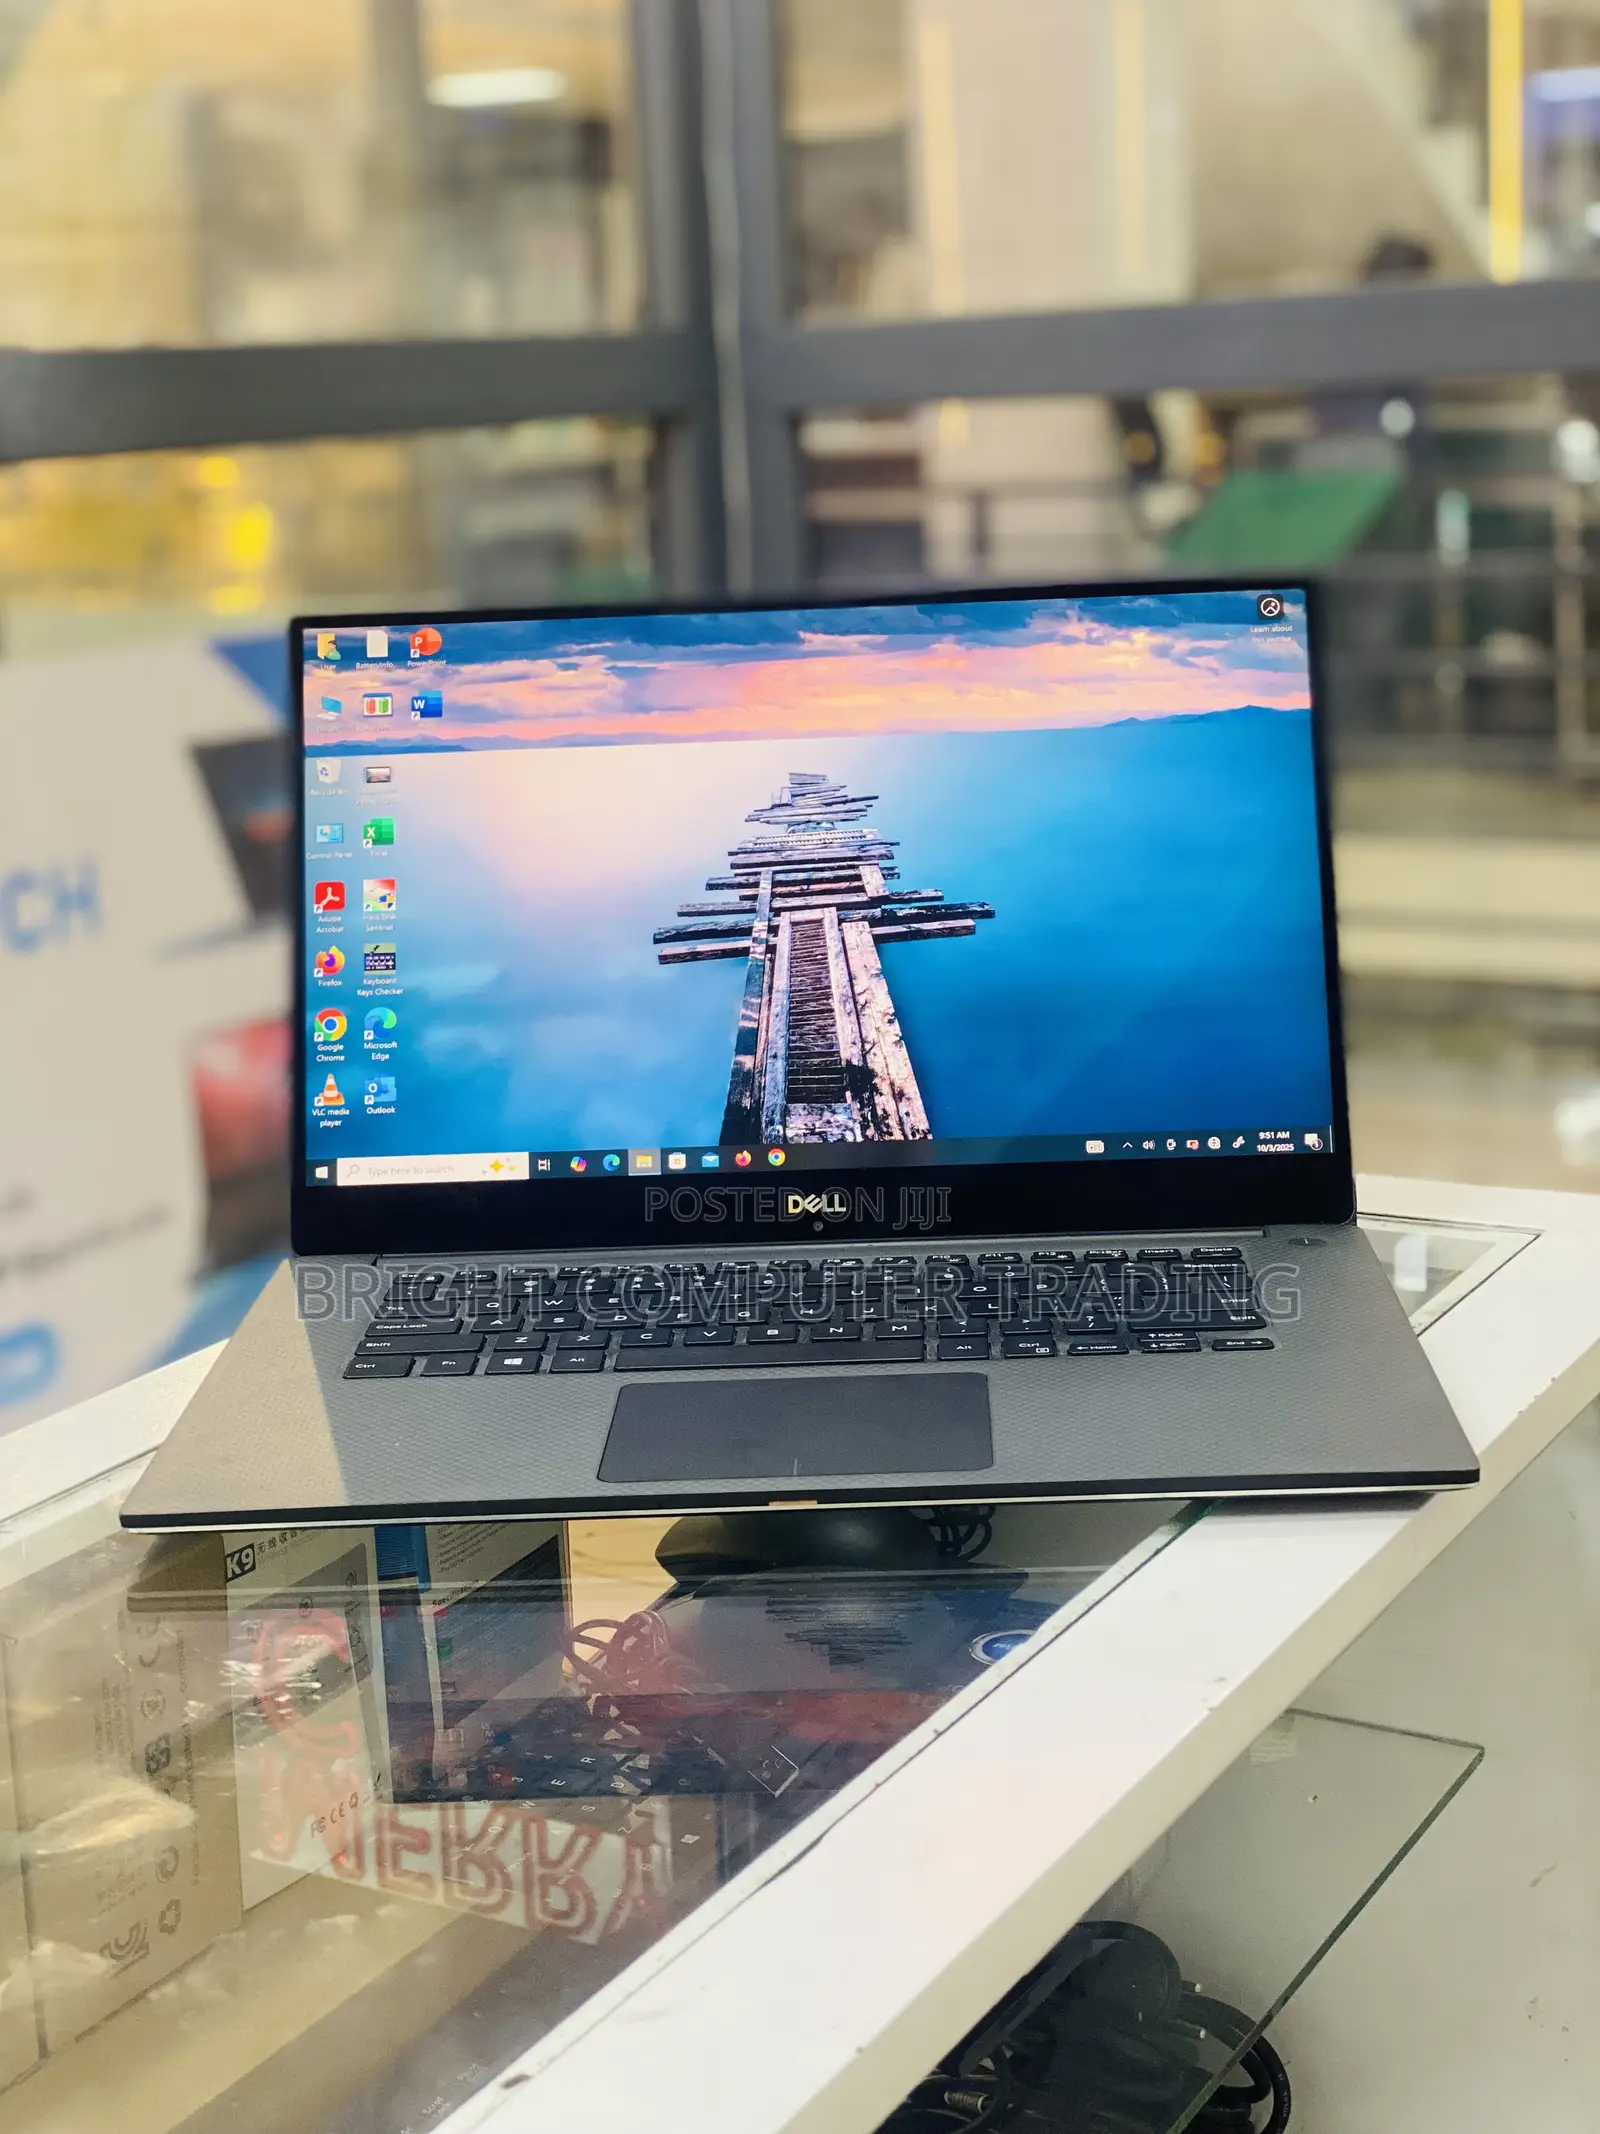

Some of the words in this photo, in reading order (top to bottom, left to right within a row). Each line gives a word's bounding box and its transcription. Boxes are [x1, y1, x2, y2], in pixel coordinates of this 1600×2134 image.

[1249, 625, 1270, 633] Learn
[1271, 624, 1293, 632] about
[414, 637, 423, 647] P
[407, 659, 447, 668] PowerPoint
[413, 699, 425, 709] W
[366, 827, 376, 837] X
[306, 852, 332, 860] Control
[370, 849, 388, 857] Excel
[317, 915, 342, 923] Adobe
[316, 925, 344, 934] Acrobat
[365, 923, 394, 932] Sentinel
[318, 979, 343, 987] Firefox
[363, 977, 397, 986] Keyboard
[357, 989, 374, 997] Keys
[375, 987, 404, 996] Checker
[317, 1043, 344, 1053] Google
[364, 1041, 398, 1050] Microsoft
[316, 1053, 345, 1063] Chrome
[371, 1052, 390, 1062] Edge
[312, 1108, 326, 1117] VLC
[327, 1108, 350, 1116] media
[366, 1106, 396, 1115] Outlook
[319, 1118, 342, 1129] player
[1258, 1131, 1275, 1140] 9:51
[1276, 1130, 1290, 1139] AM
[1256, 1143, 1295, 1153] 10/3/2025
[368, 1166, 389, 1178] Type
[390, 1166, 410, 1175] here
[413, 1166, 423, 1175] to
[424, 1165, 454, 1174] search
[787, 1193, 847, 1214] DELL
[891, 1324, 908, 1332] M
[226, 1547, 255, 1579] K9
